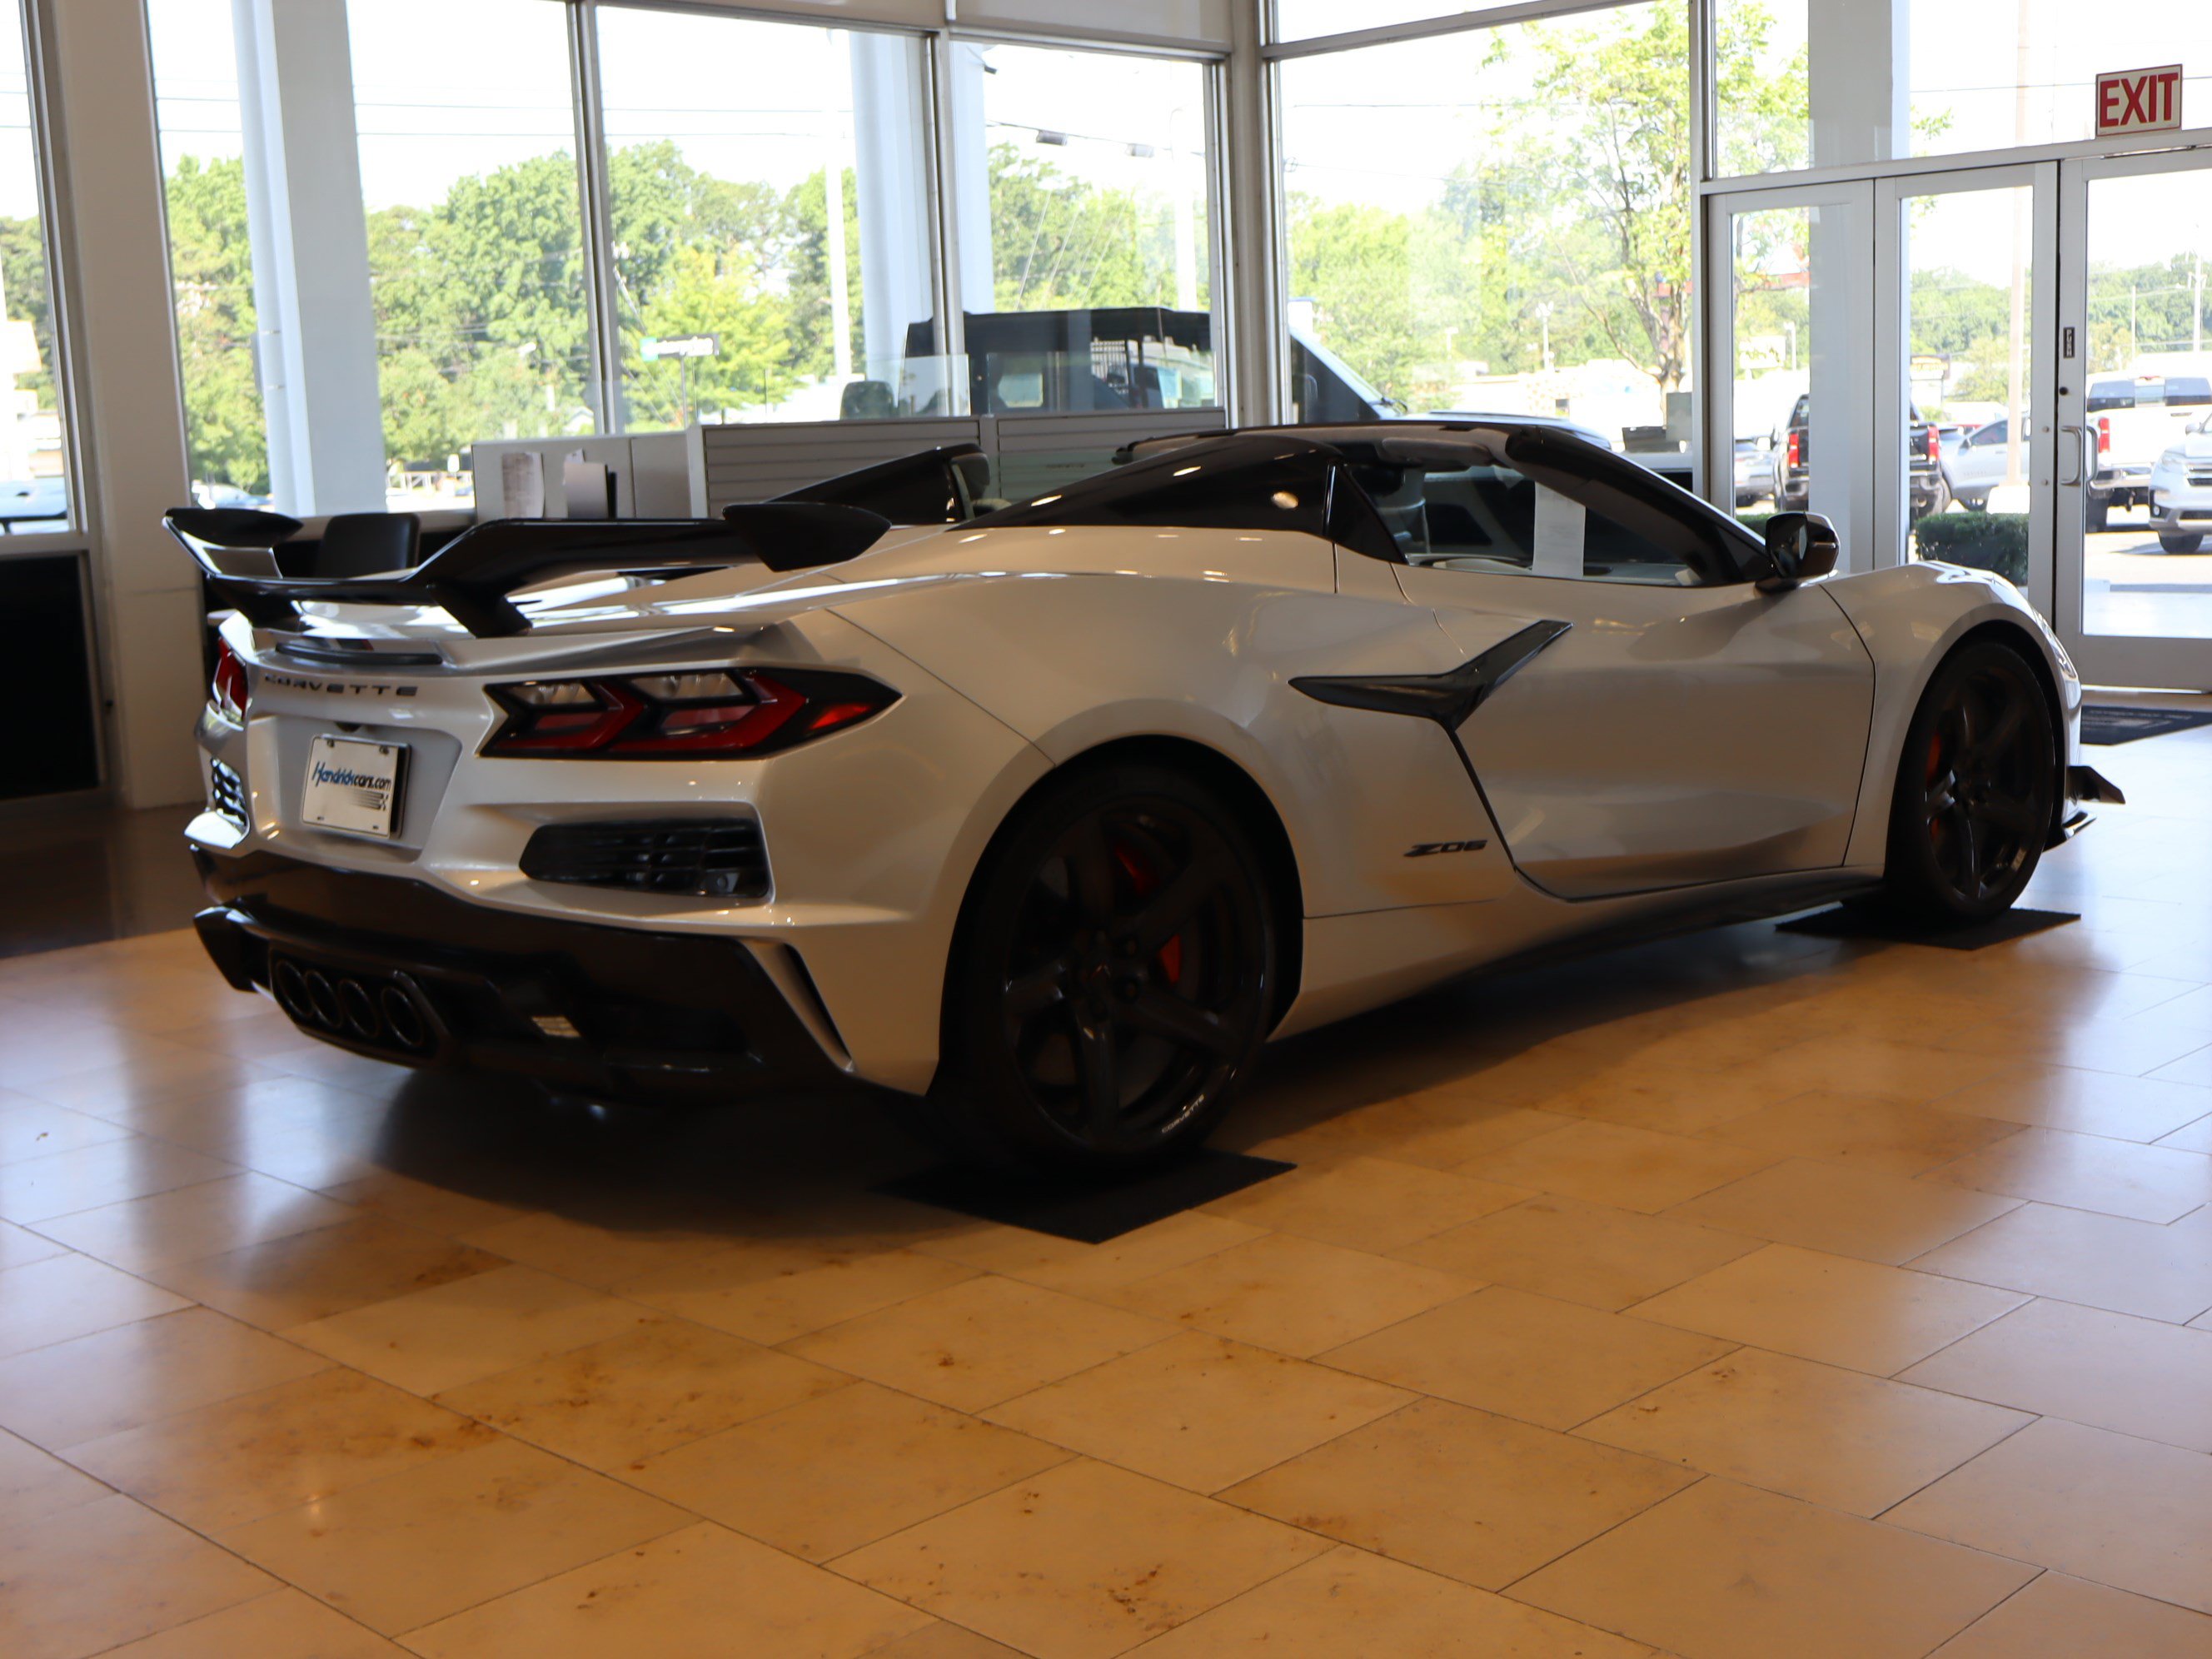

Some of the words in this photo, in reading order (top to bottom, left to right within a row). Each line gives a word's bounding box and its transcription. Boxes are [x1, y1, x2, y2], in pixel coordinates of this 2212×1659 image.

[2100, 72, 2179, 127] EXIT
[265, 674, 418, 696] CORVETTE
[1403, 839, 1487, 857] Z06
